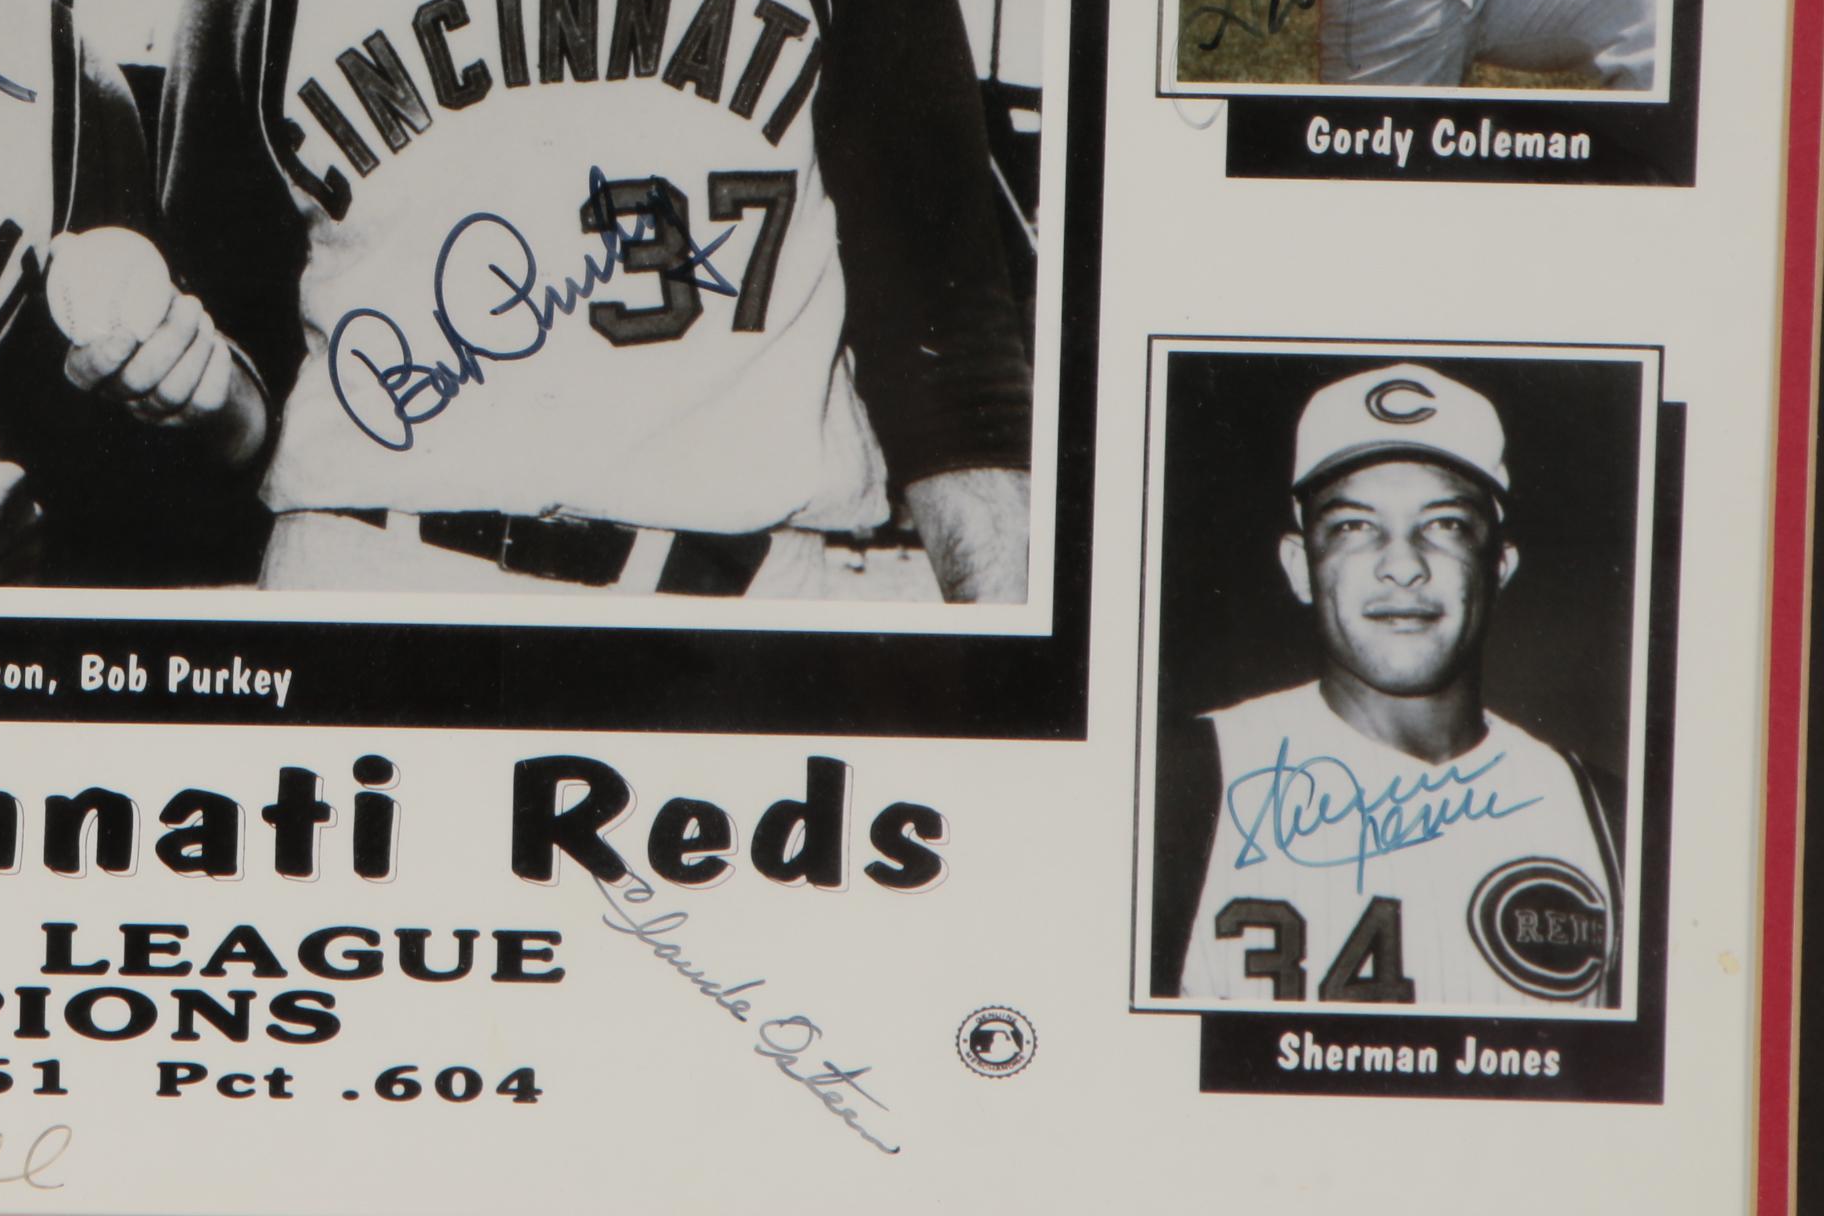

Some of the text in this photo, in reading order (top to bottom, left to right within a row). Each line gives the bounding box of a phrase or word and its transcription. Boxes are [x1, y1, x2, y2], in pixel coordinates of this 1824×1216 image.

[1306, 115, 1590, 168] Gordy Coleman
[579, 170, 798, 348] 37
[1364, 378, 1438, 425] C
[80, 653, 148, 693] Bob
[168, 655, 293, 708] Purkey
[512, 754, 948, 894] Reds
[40, 921, 566, 983] LEAGUE
[1213, 896, 1417, 1004] 34
[1277, 1031, 1562, 1077] Sherman Jones
[156, 1061, 294, 1099] Pct
[342, 1065, 543, 1103] .604
